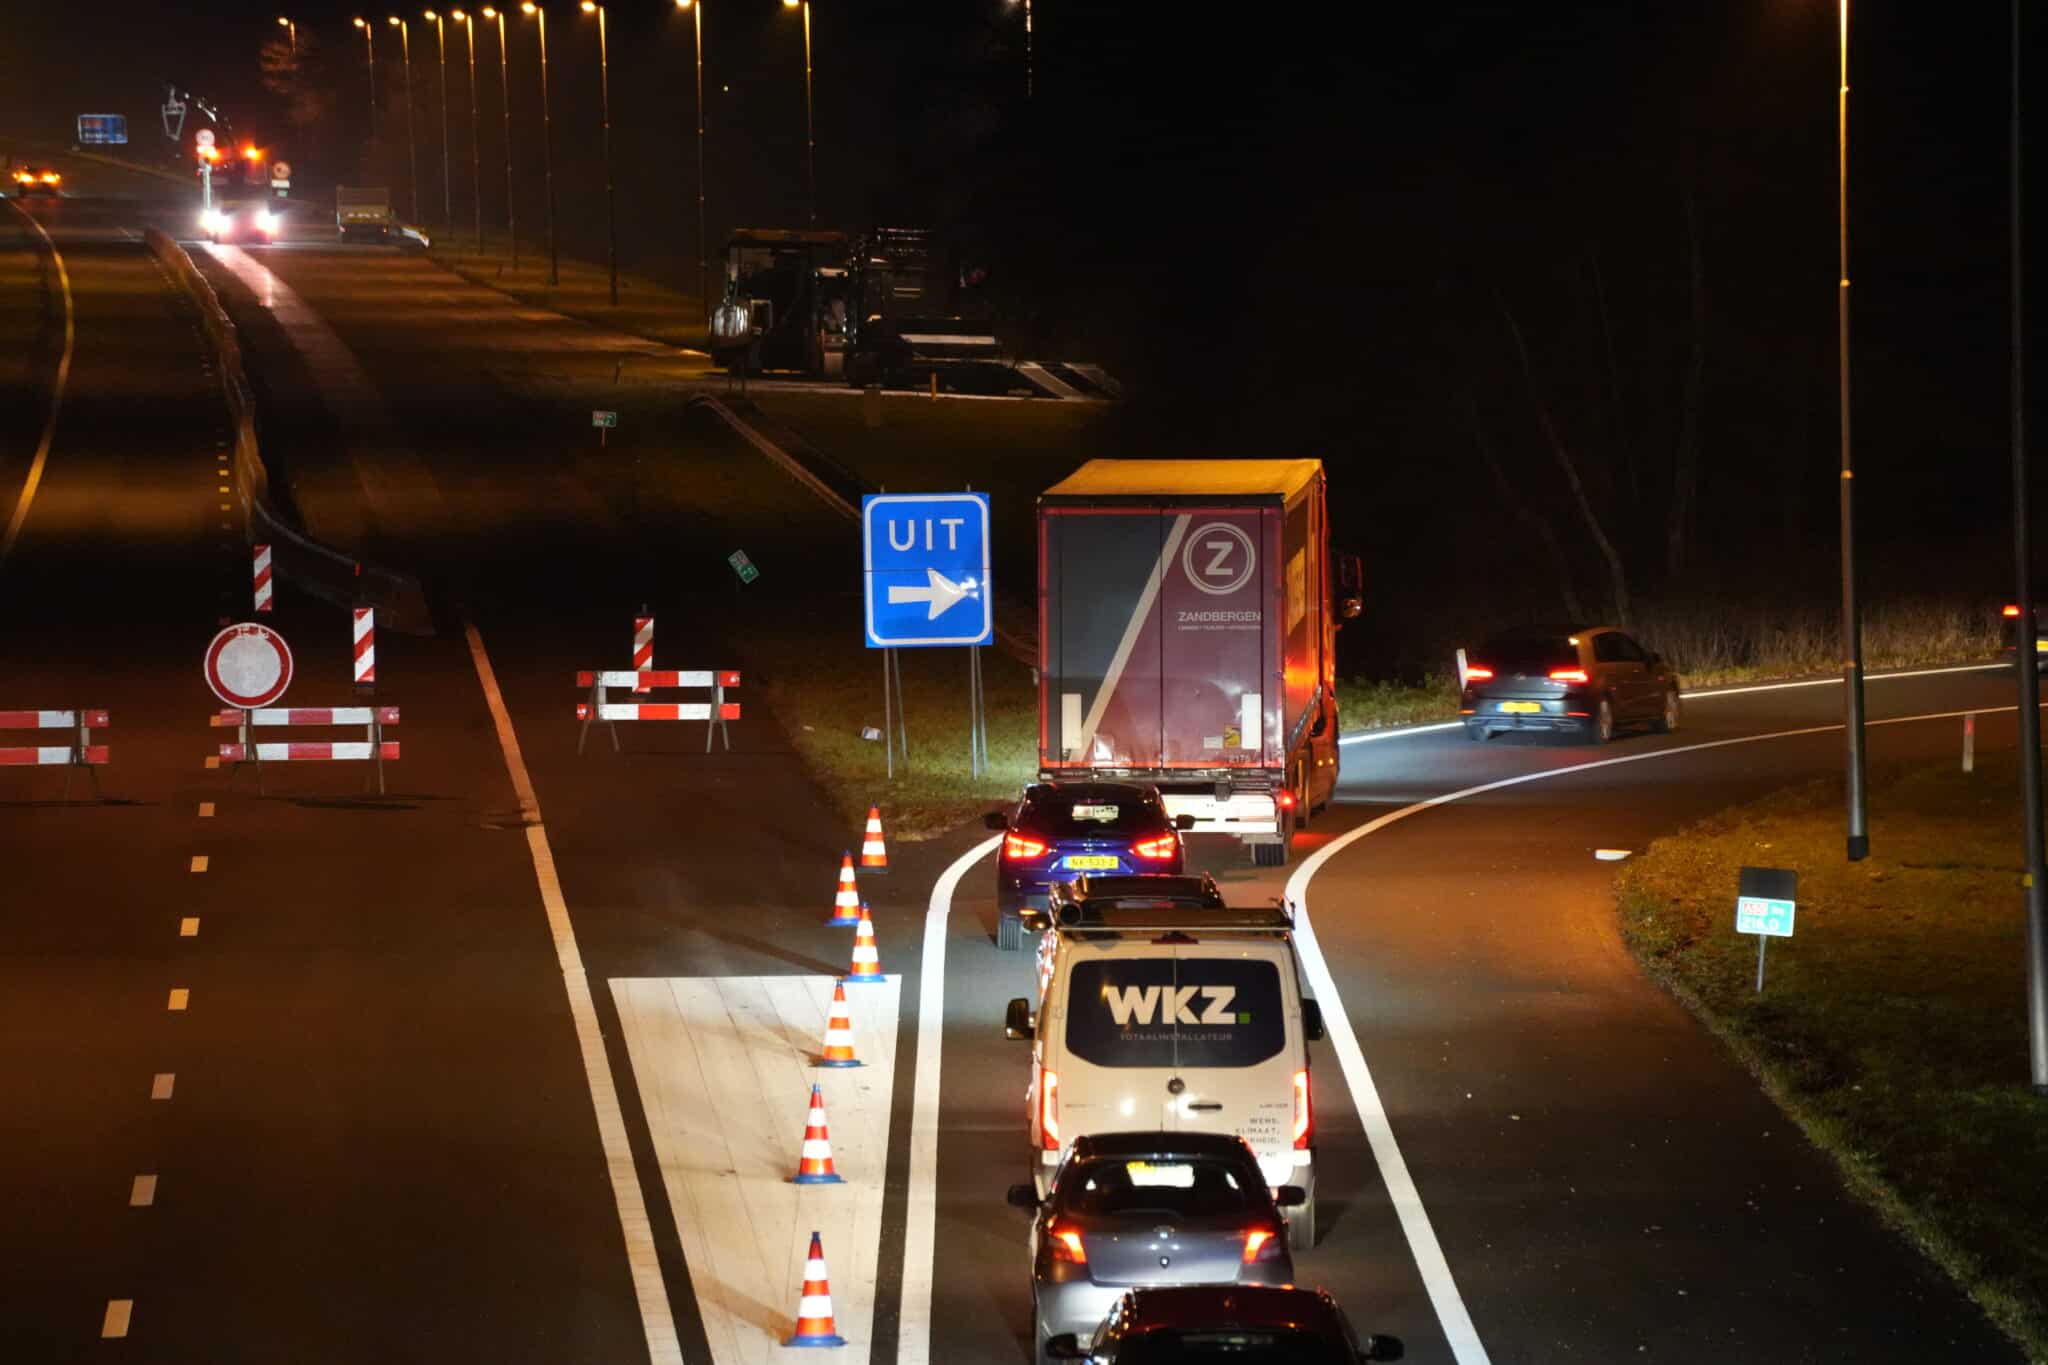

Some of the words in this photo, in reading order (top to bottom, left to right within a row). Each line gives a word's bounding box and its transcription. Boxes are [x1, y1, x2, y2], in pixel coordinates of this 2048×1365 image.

[888, 518, 965, 551] UIT
[1205, 541, 1234, 576] Z
[1177, 611, 1261, 622] ZANDBERGEN
[1120, 1032, 1233, 1041] TOTAALINSTALLATEUR
